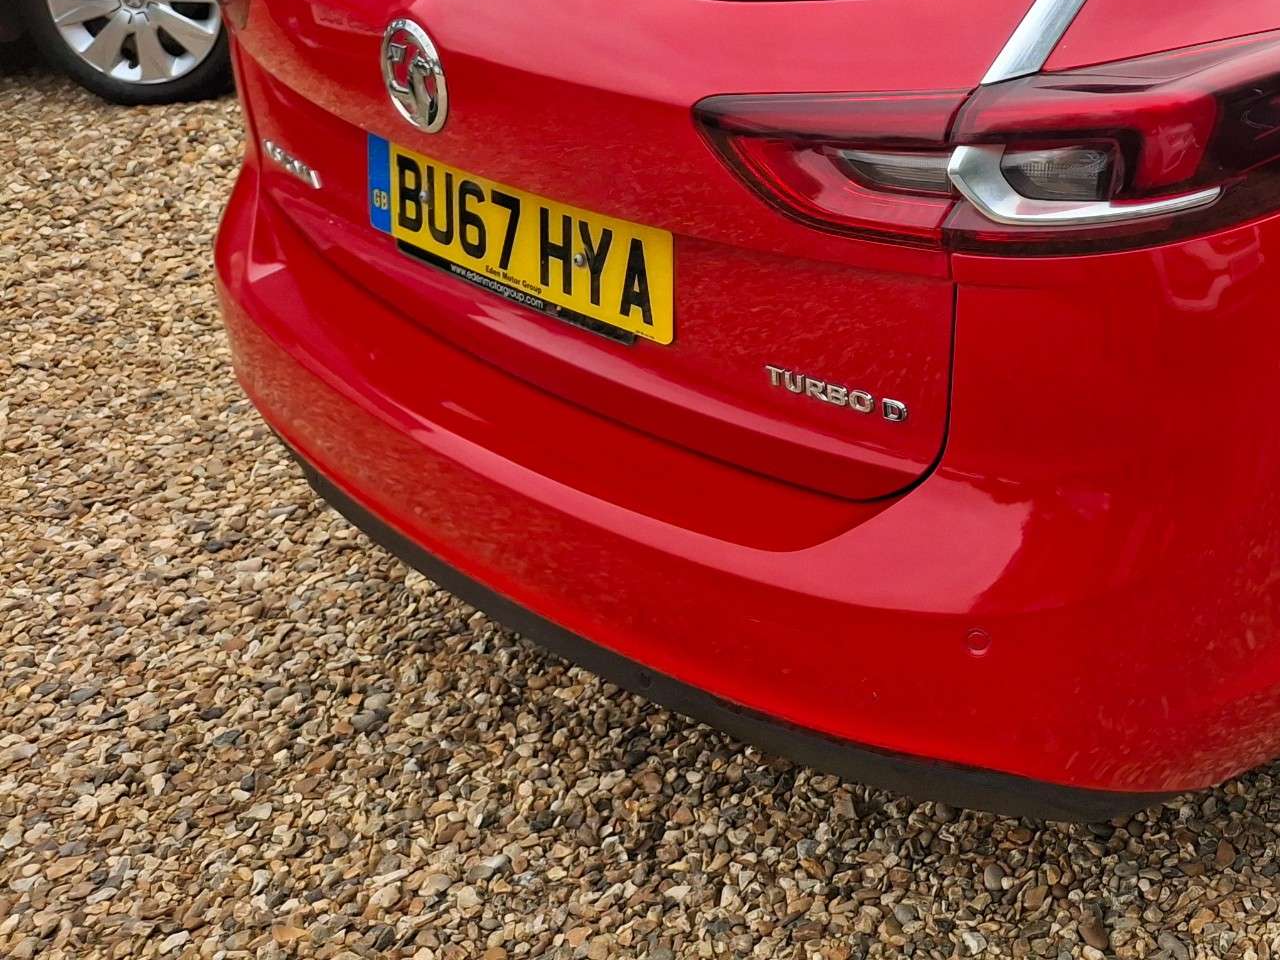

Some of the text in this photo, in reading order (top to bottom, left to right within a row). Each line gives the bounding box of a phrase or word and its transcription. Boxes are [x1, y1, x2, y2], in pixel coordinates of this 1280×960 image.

[373, 188, 389, 210] GB
[396, 153, 520, 270] BU67
[539, 206, 654, 327] HYA
[450, 263, 544, 309] www.edenmotorgroup.com
[485, 264, 543, 295] Eden Motor Group
[765, 363, 908, 422] TURBO D
